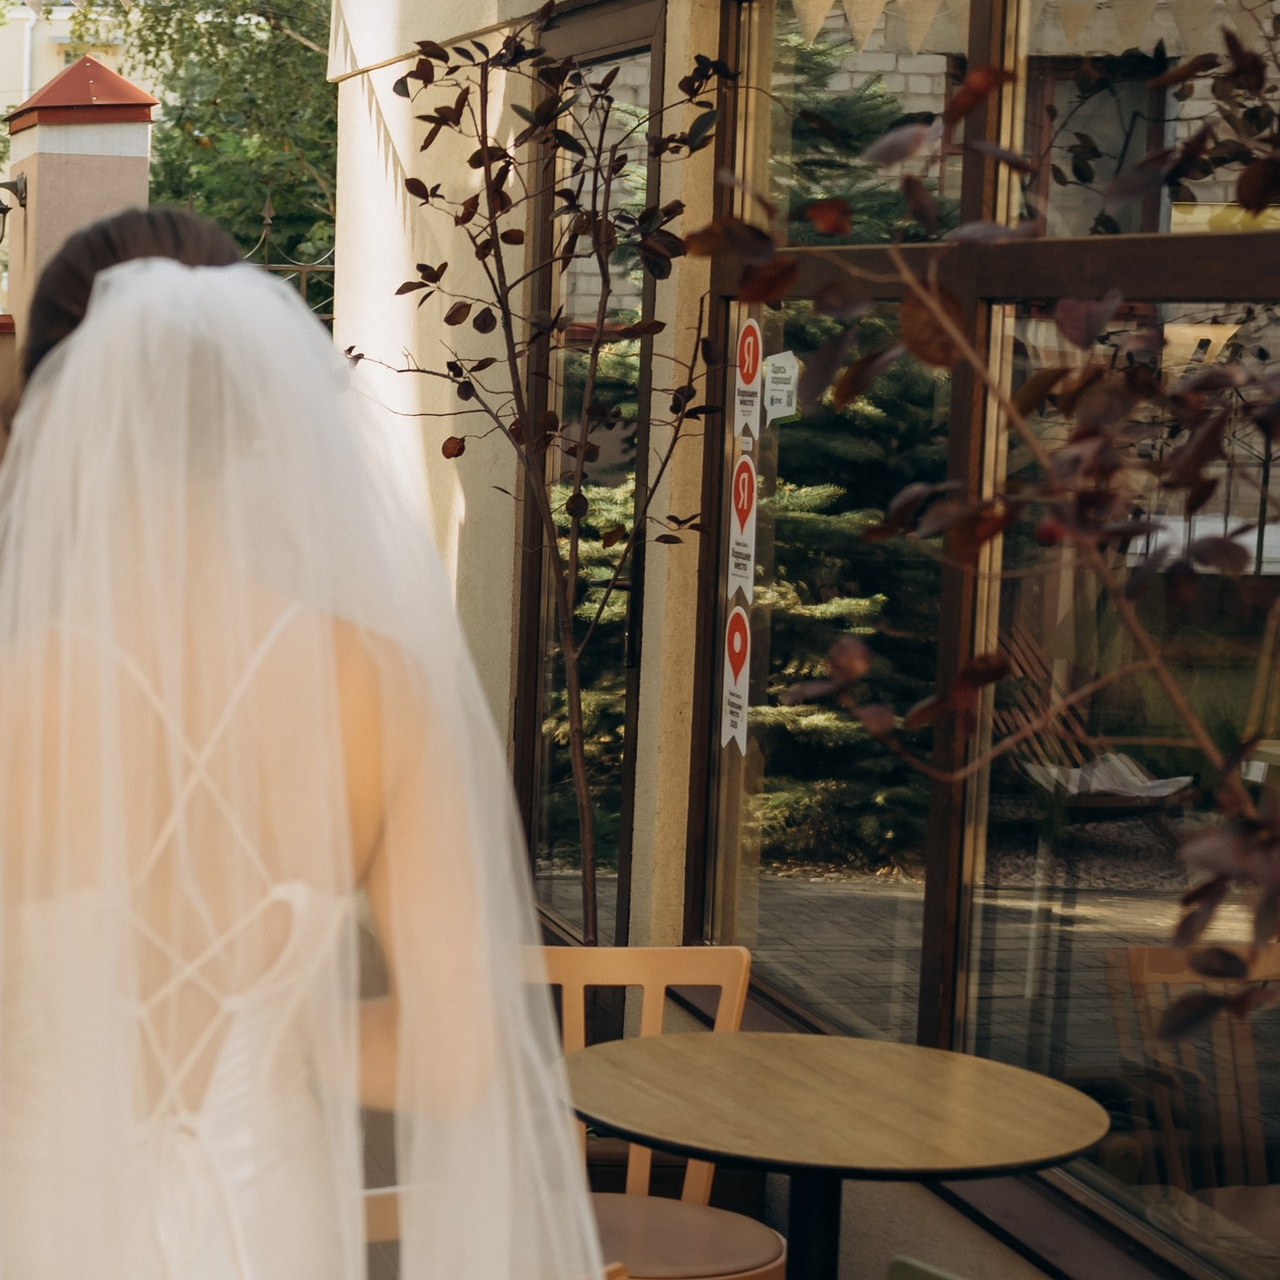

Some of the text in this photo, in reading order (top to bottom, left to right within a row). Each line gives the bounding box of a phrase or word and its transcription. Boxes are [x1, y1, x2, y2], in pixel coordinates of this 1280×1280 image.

[743, 336, 754, 374] Я
[737, 388, 758, 398] Хорошее
[740, 399, 754, 407] место
[738, 472, 748, 509] Я
[731, 548, 751, 562] Хорошее
